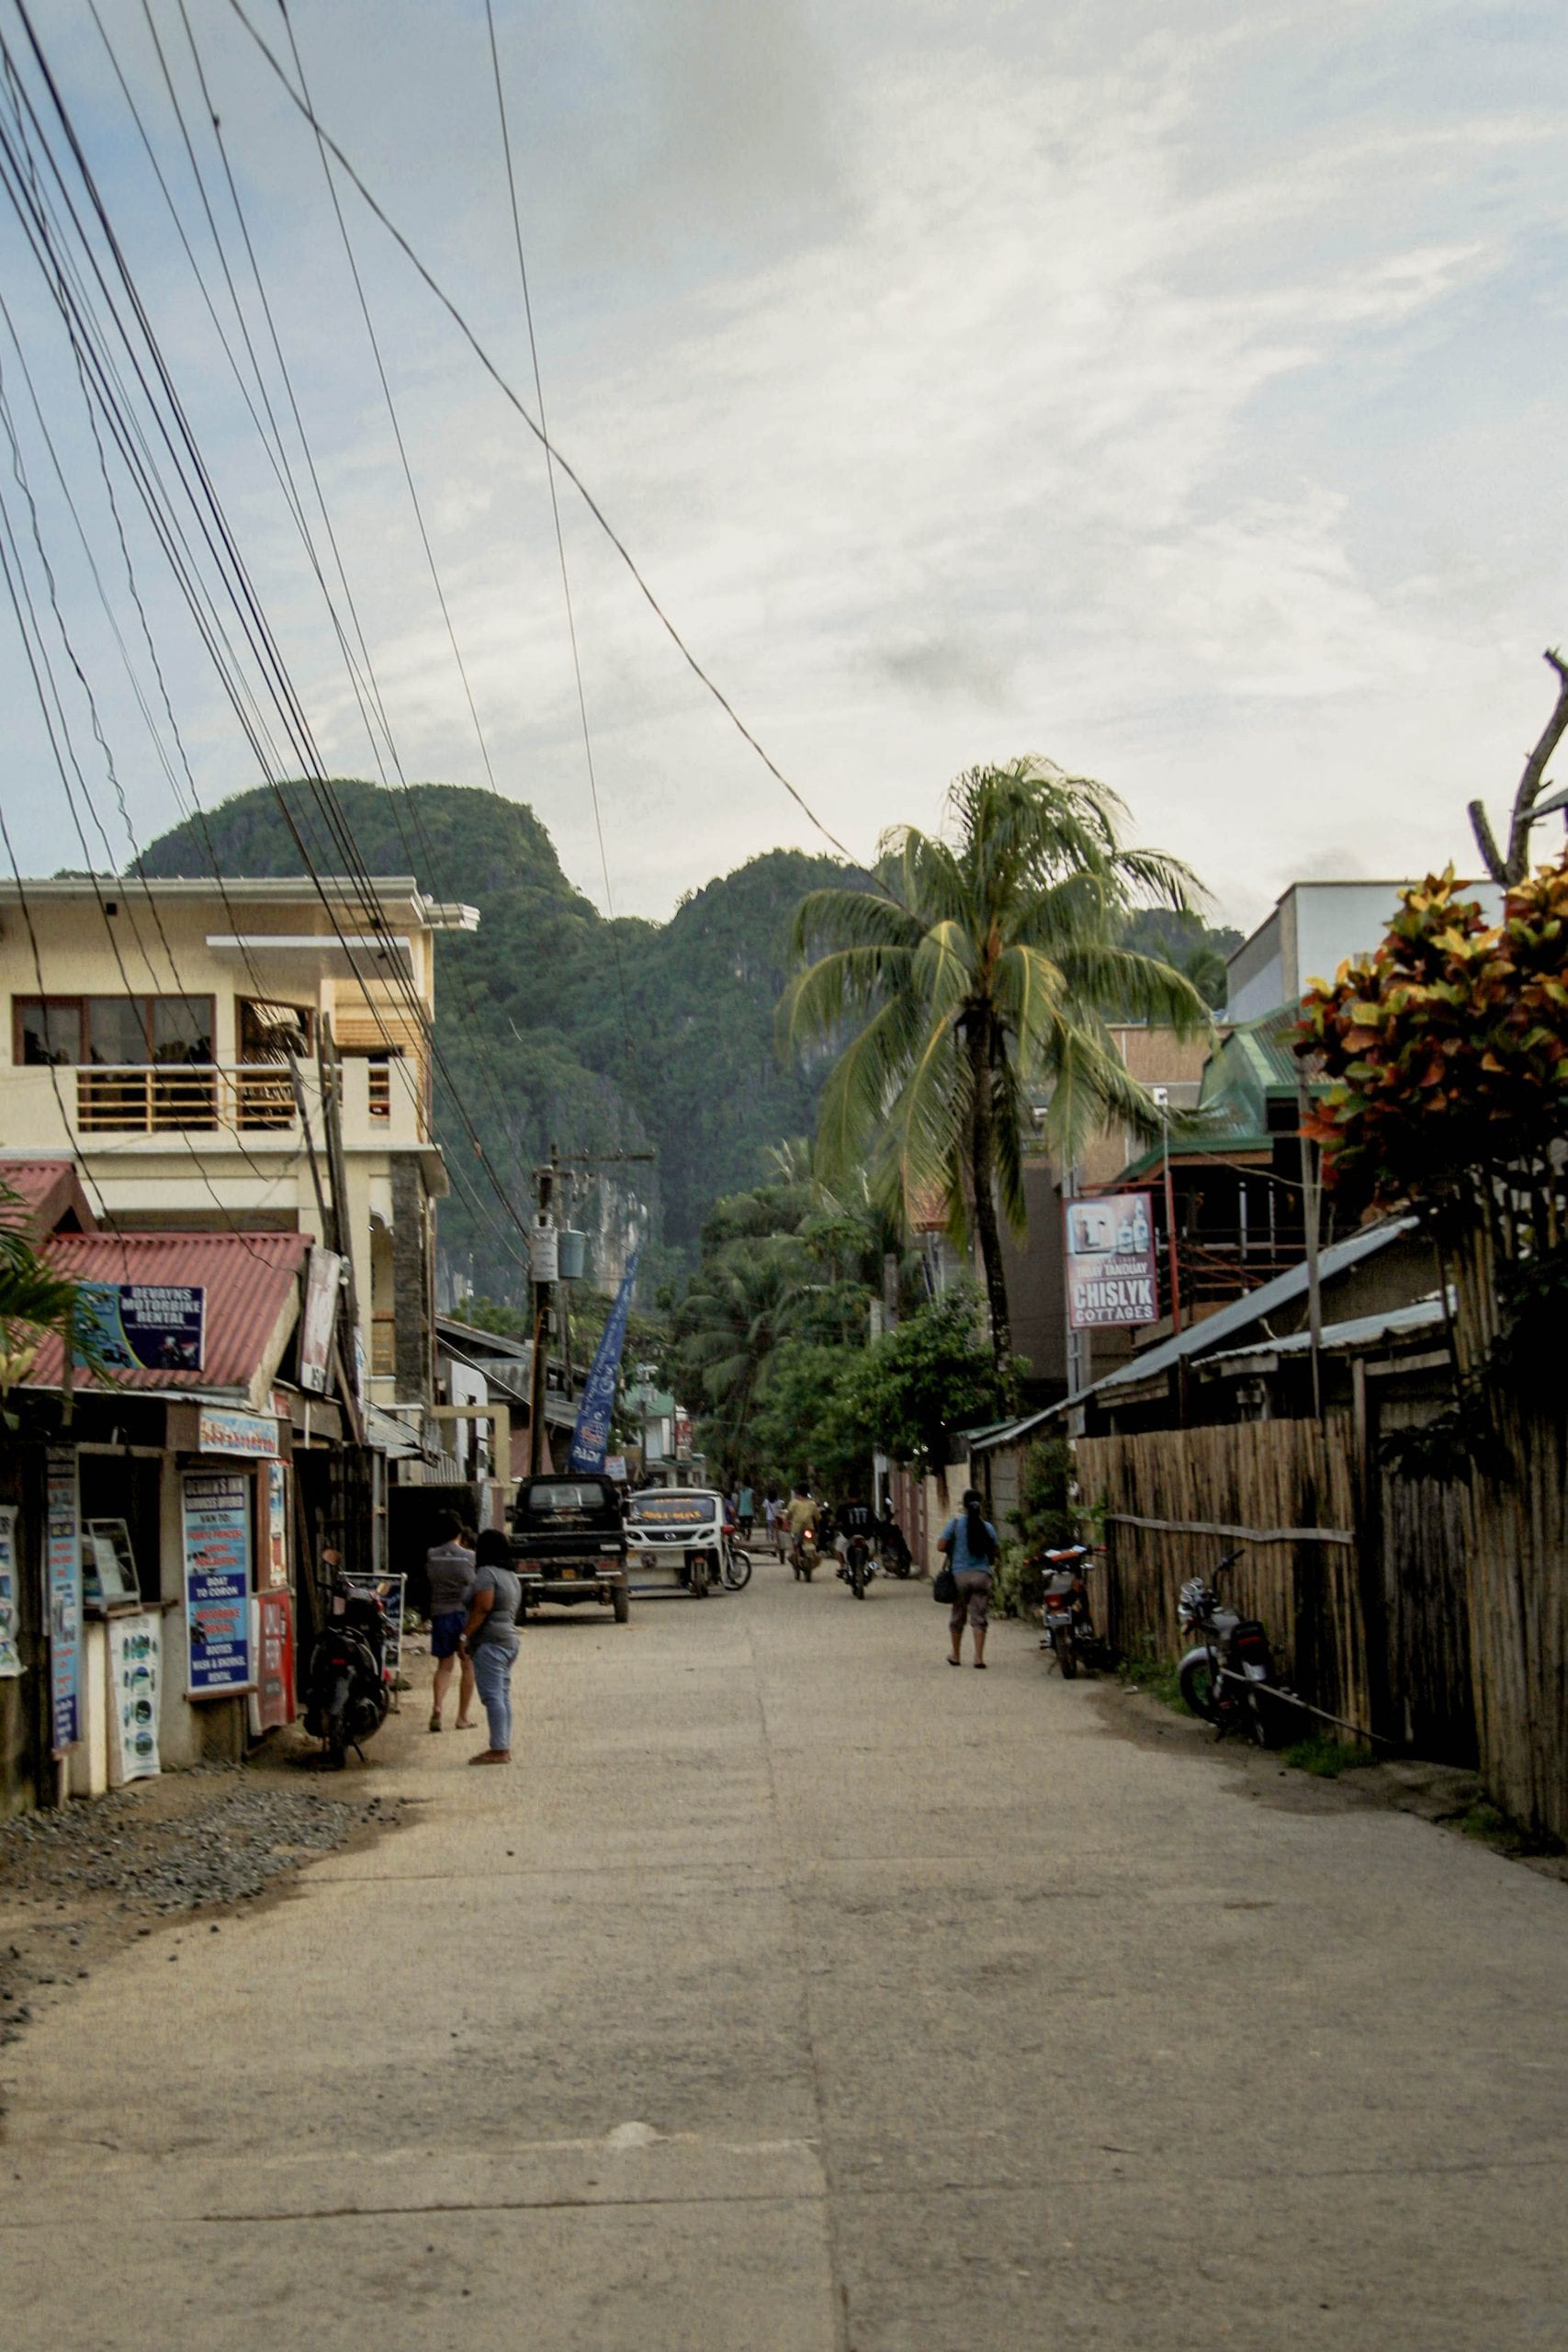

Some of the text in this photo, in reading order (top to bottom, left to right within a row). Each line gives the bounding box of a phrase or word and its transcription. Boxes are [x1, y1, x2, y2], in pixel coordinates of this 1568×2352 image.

[131, 1286, 193, 1300] DEVAYNS
[1073, 1279, 1152, 1308] CHISLYK
[121, 1298, 201, 1312] MOTORBIKE
[136, 1311, 186, 1324] RENTAL
[1076, 1305, 1153, 1323] COTTAGES
[207, 1577, 229, 1588] BOAT
[197, 1585, 239, 1598] TO CORON
